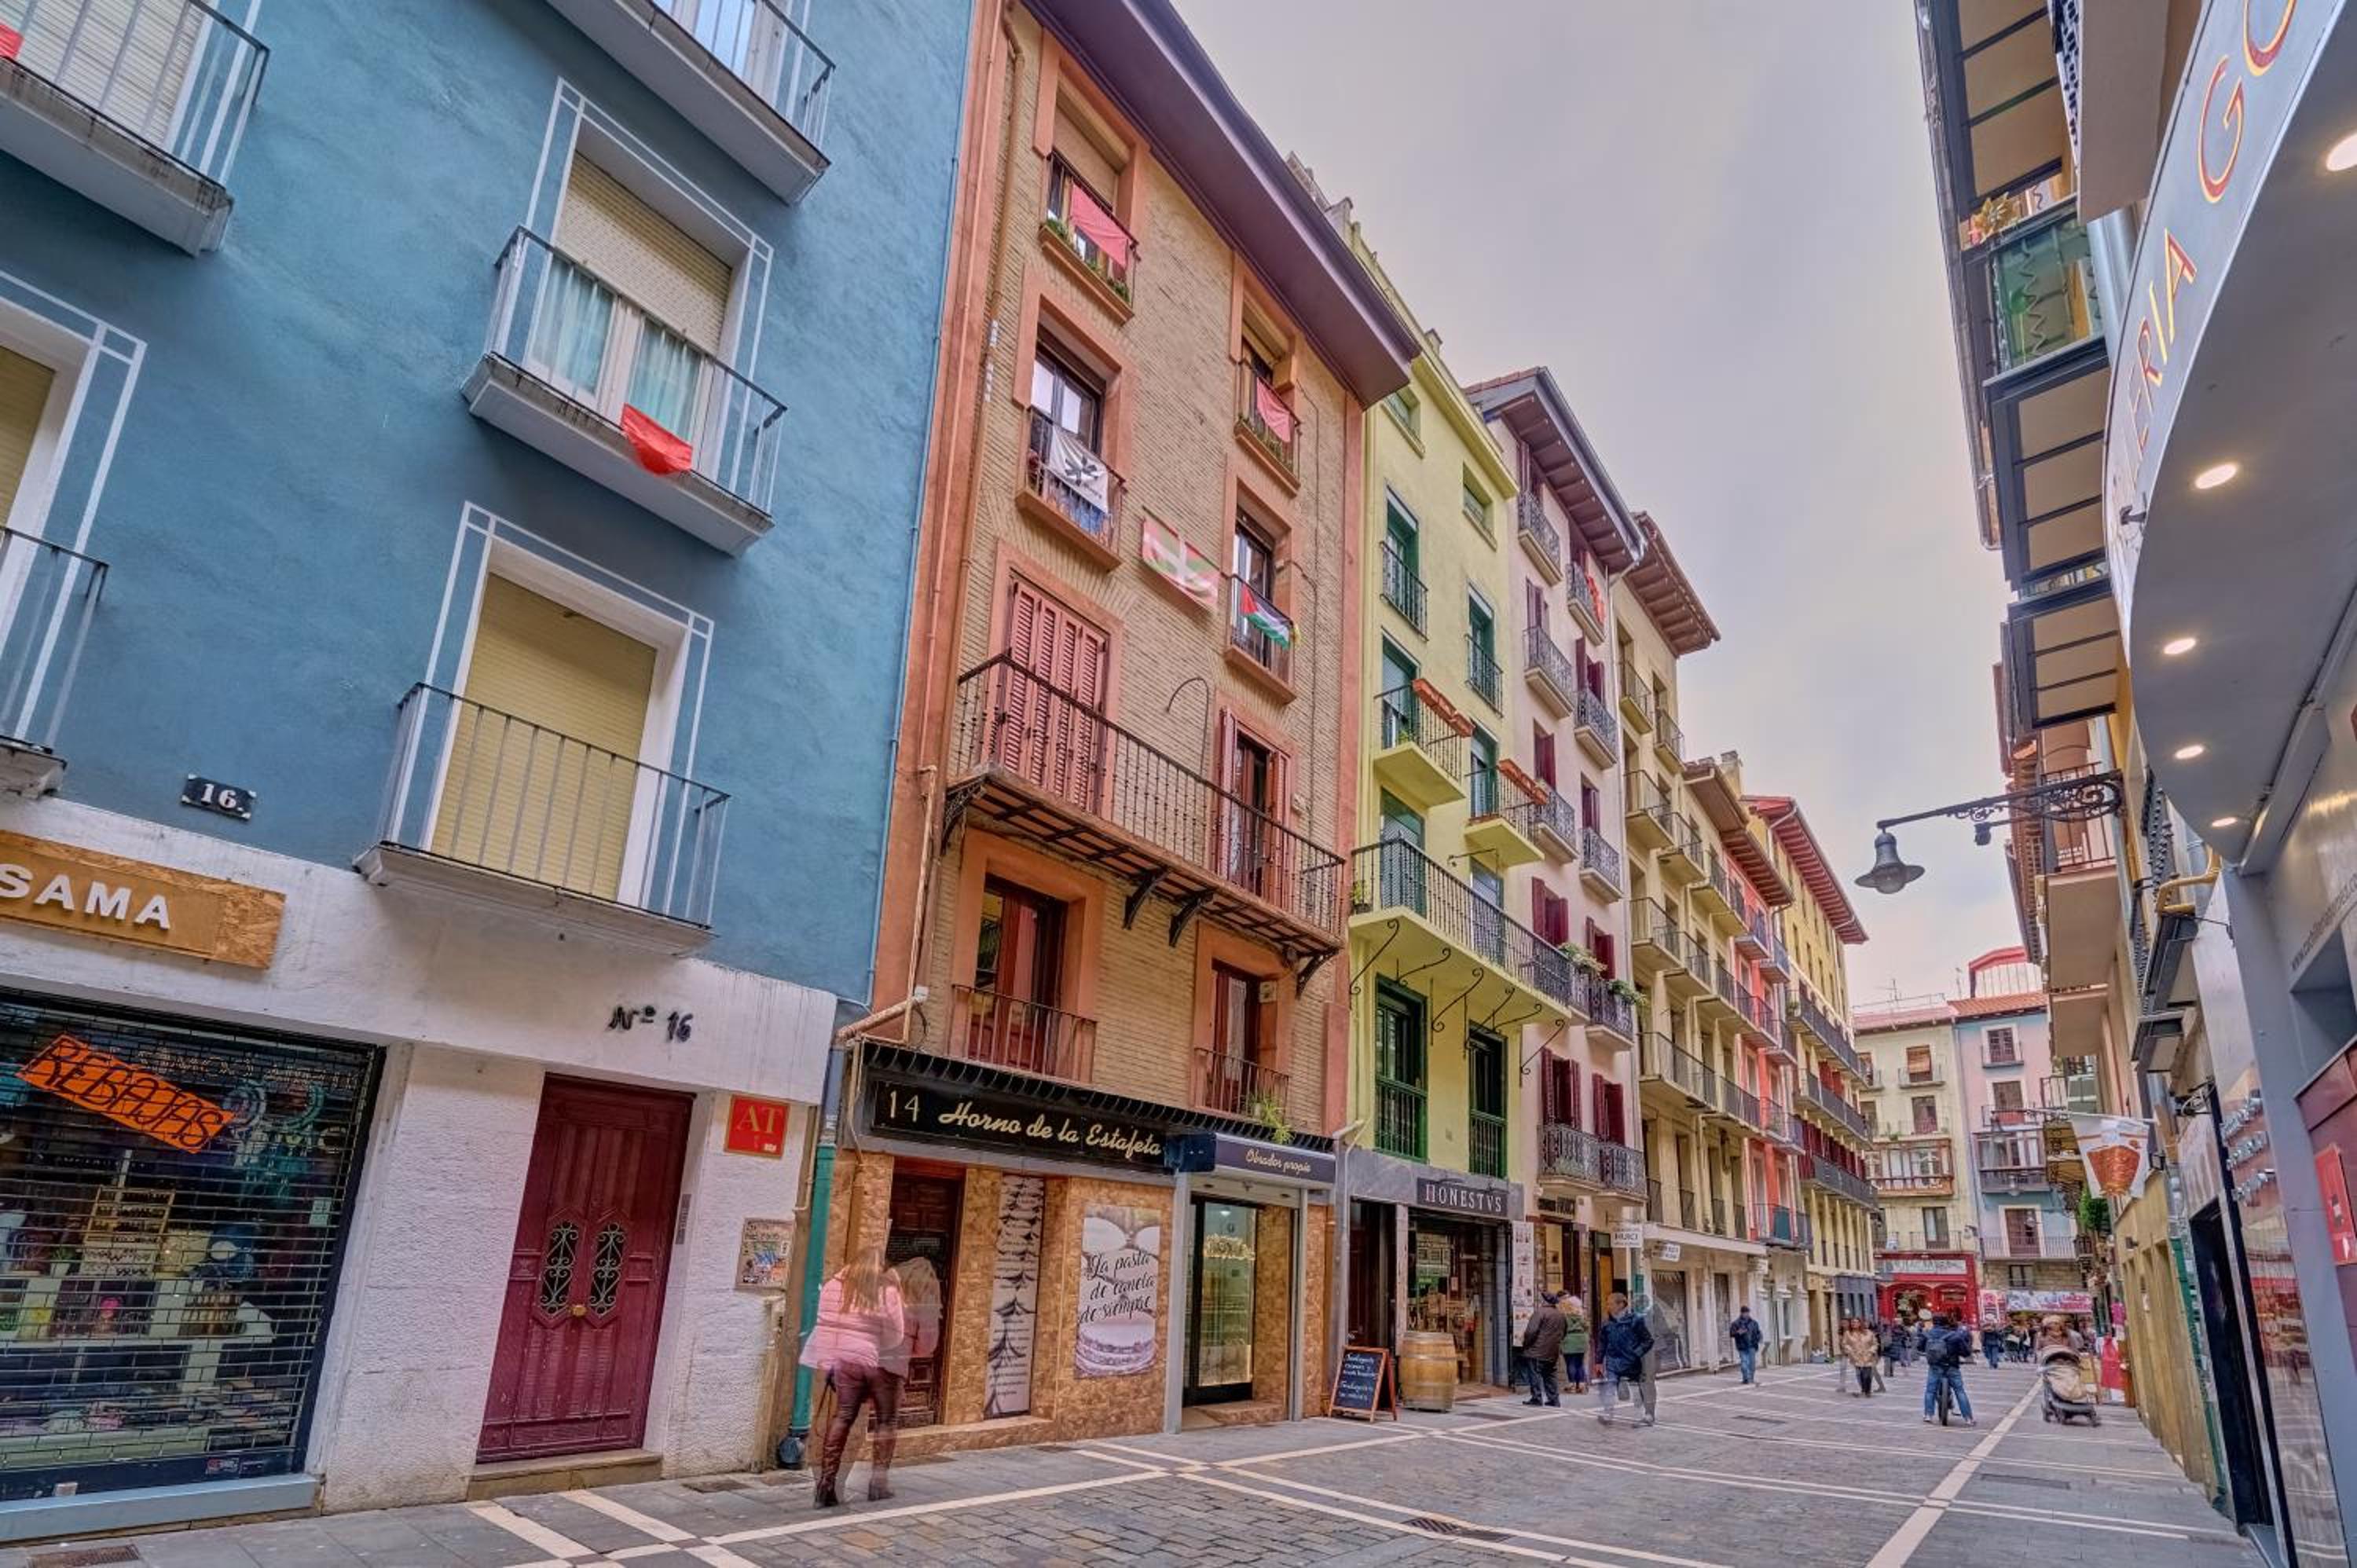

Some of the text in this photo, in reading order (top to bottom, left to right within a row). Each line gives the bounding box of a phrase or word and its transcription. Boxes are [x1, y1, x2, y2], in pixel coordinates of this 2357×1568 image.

[0, 863, 171, 931] SAMA
[666, 1010, 694, 1043] 16
[26, 1036, 225, 1149] REBAJAS
[889, 1090, 920, 1123] 14
[734, 1105, 784, 1134] AT
[938, 1101, 1164, 1159] Horno de la Estafeta
[1424, 1183, 1502, 1212] HONESTVS
[1087, 1249, 1151, 1281] La pasta
[1090, 1271, 1155, 1300] de canela
[1079, 1295, 1151, 1324] de siempre
